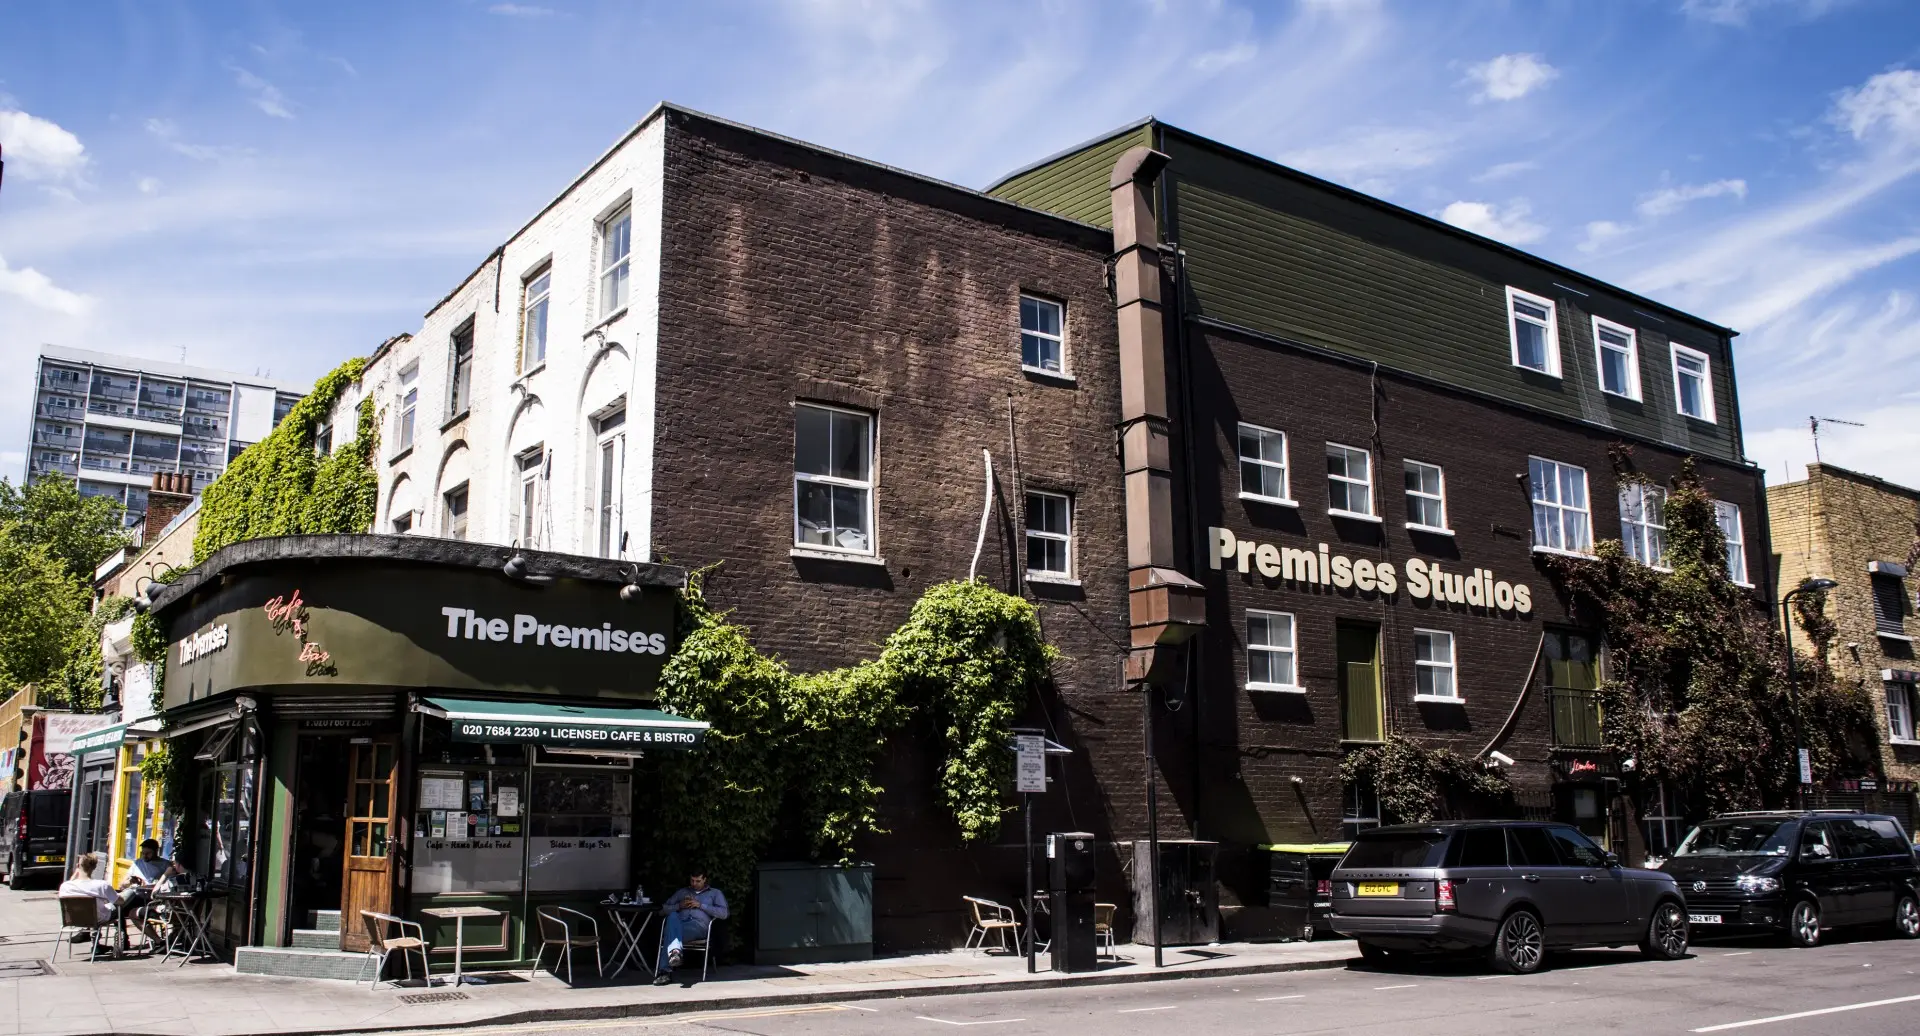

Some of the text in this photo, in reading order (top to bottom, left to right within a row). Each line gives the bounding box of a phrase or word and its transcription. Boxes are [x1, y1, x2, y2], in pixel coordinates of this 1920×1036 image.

[1209, 526, 1532, 613] Premises Studios
[179, 622, 228, 665] The Premises
[441, 606, 666, 655] The Premises
[299, 642, 330, 662] Bar
[462, 725, 695, 743] 020 7684 2230 LICENSED CAFE & BISTRO
[495, 840, 512, 849] Food
